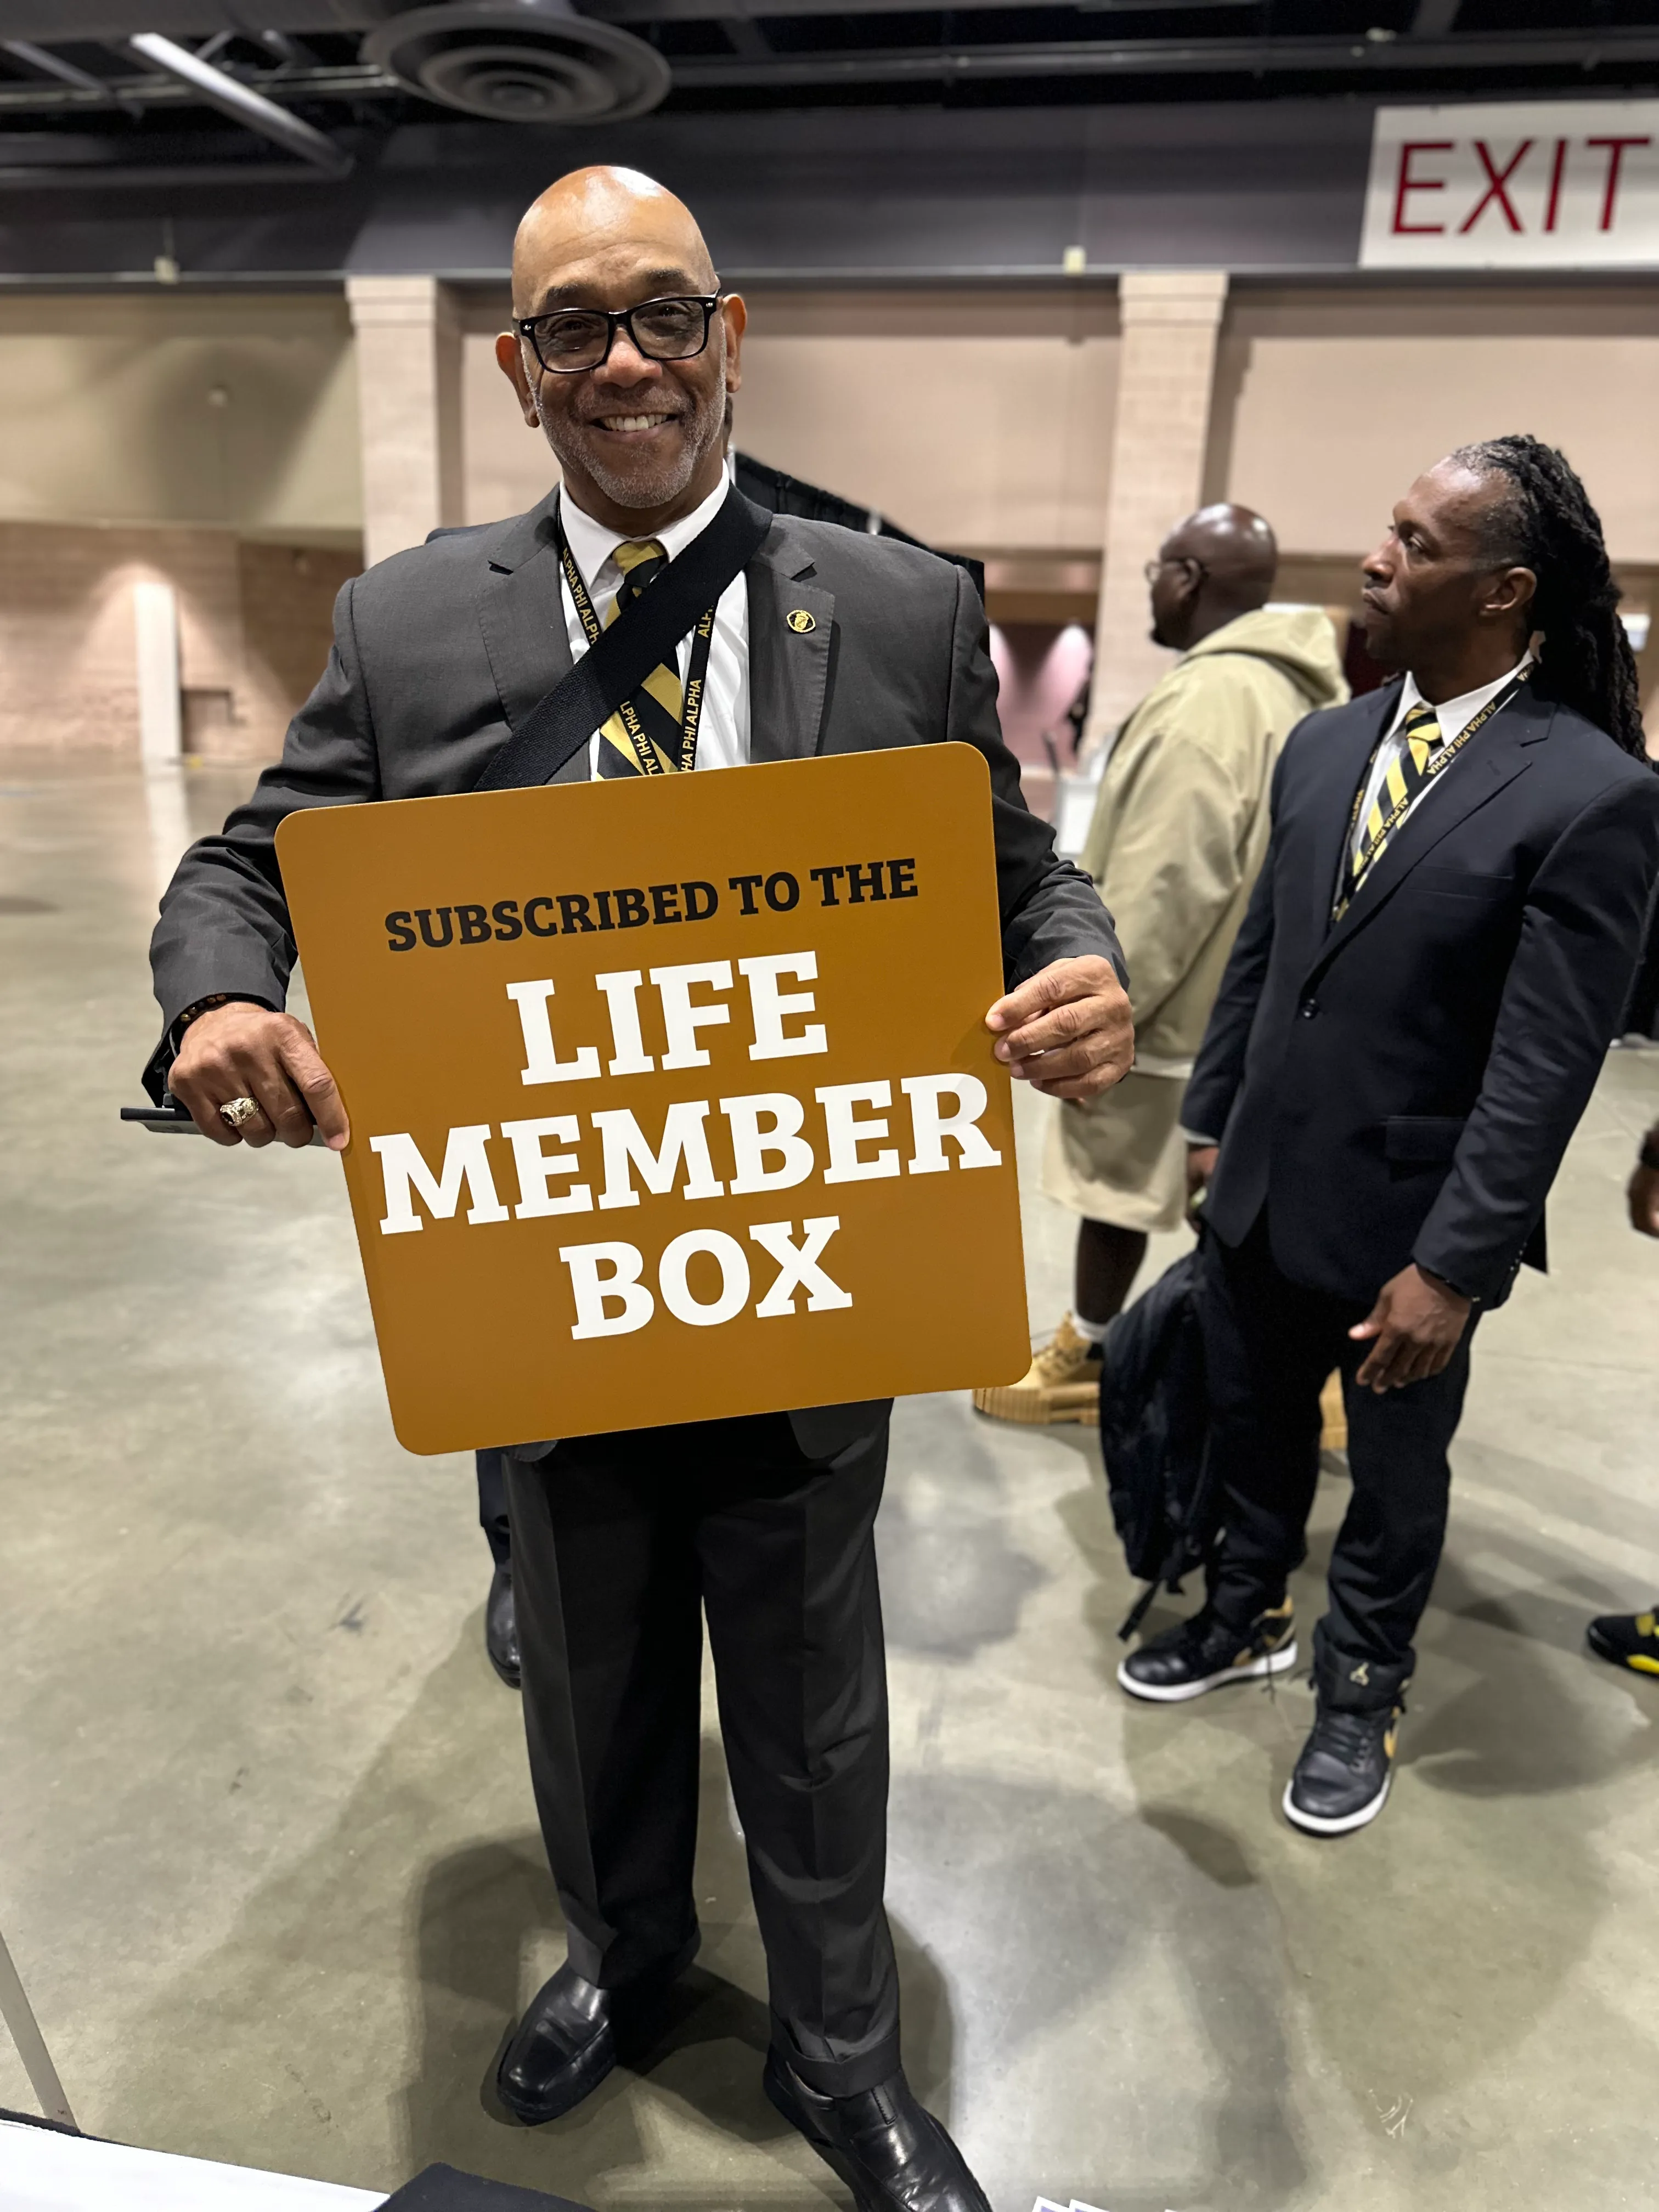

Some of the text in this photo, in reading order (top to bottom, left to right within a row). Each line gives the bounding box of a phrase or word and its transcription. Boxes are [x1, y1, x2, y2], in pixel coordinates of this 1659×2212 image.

[1390, 137, 1651, 236] EXIT
[563, 548, 600, 645] ALPHA PHI ALPH
[619, 701, 652, 756] LPHA PHI
[682, 726, 696, 751] PHI
[686, 679, 702, 726] ALPHA
[1426, 701, 1496, 775] ALPHA PHI ALPHA
[385, 858, 918, 952] SUBSCRIBED TO THE
[506, 951, 828, 1086] LIFE
[369, 1073, 1002, 1235] MEMBER
[558, 1215, 853, 1340] BOX
